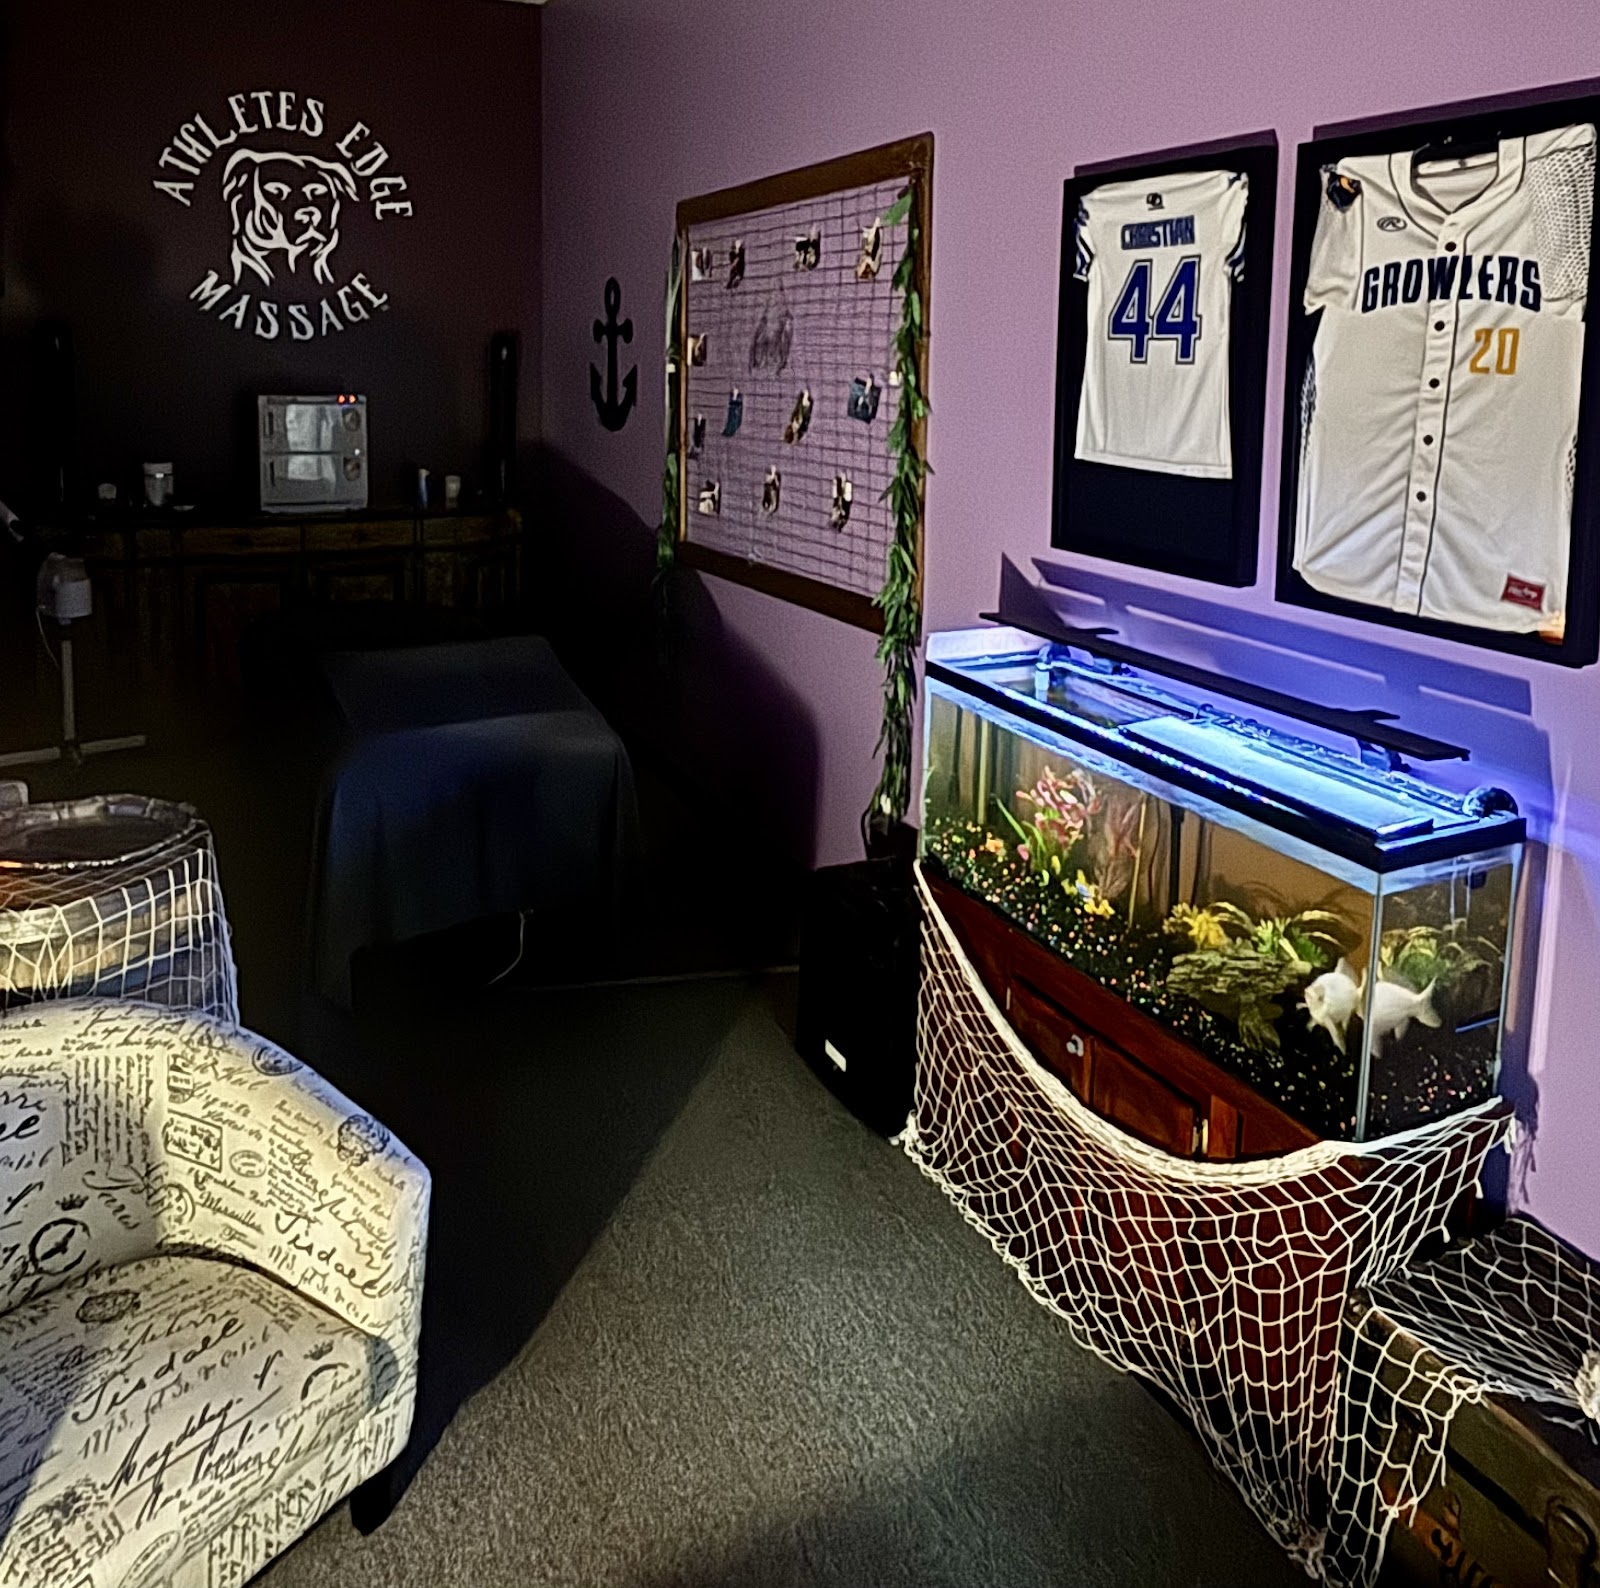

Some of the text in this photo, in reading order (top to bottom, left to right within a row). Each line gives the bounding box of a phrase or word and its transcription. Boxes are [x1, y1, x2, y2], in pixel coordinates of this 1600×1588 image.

[153, 91, 413, 220] ATHLETES EDGE
[1121, 215, 1195, 250] CHRISTIAN
[189, 269, 388, 340] MASSAGE
[1107, 254, 1202, 365] 44
[1361, 255, 1542, 314] GROWLERS
[1468, 327, 1520, 375] 20
